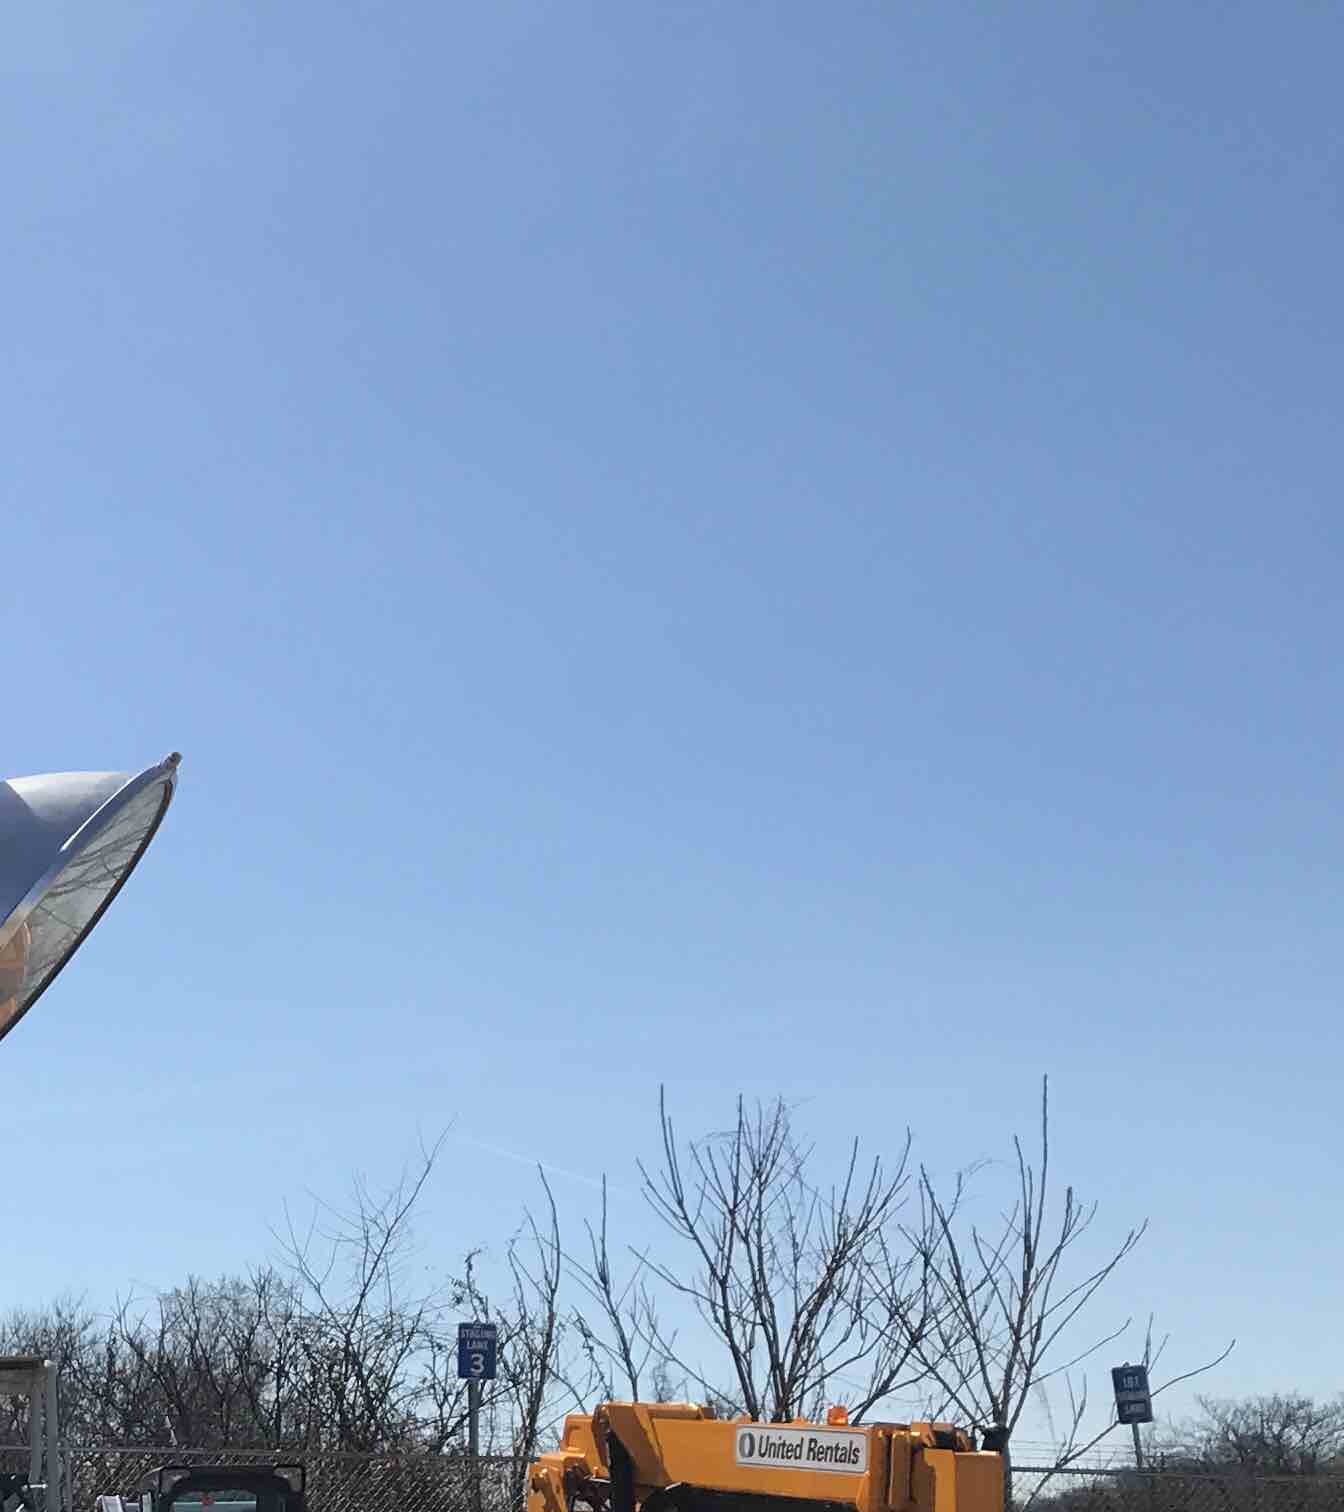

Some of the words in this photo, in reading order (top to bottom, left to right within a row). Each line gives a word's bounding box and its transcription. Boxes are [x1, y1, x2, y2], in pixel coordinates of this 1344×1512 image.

[469, 1353, 484, 1373] 3
[758, 1434, 804, 1460] United
[807, 1438, 860, 1465] Rentals
